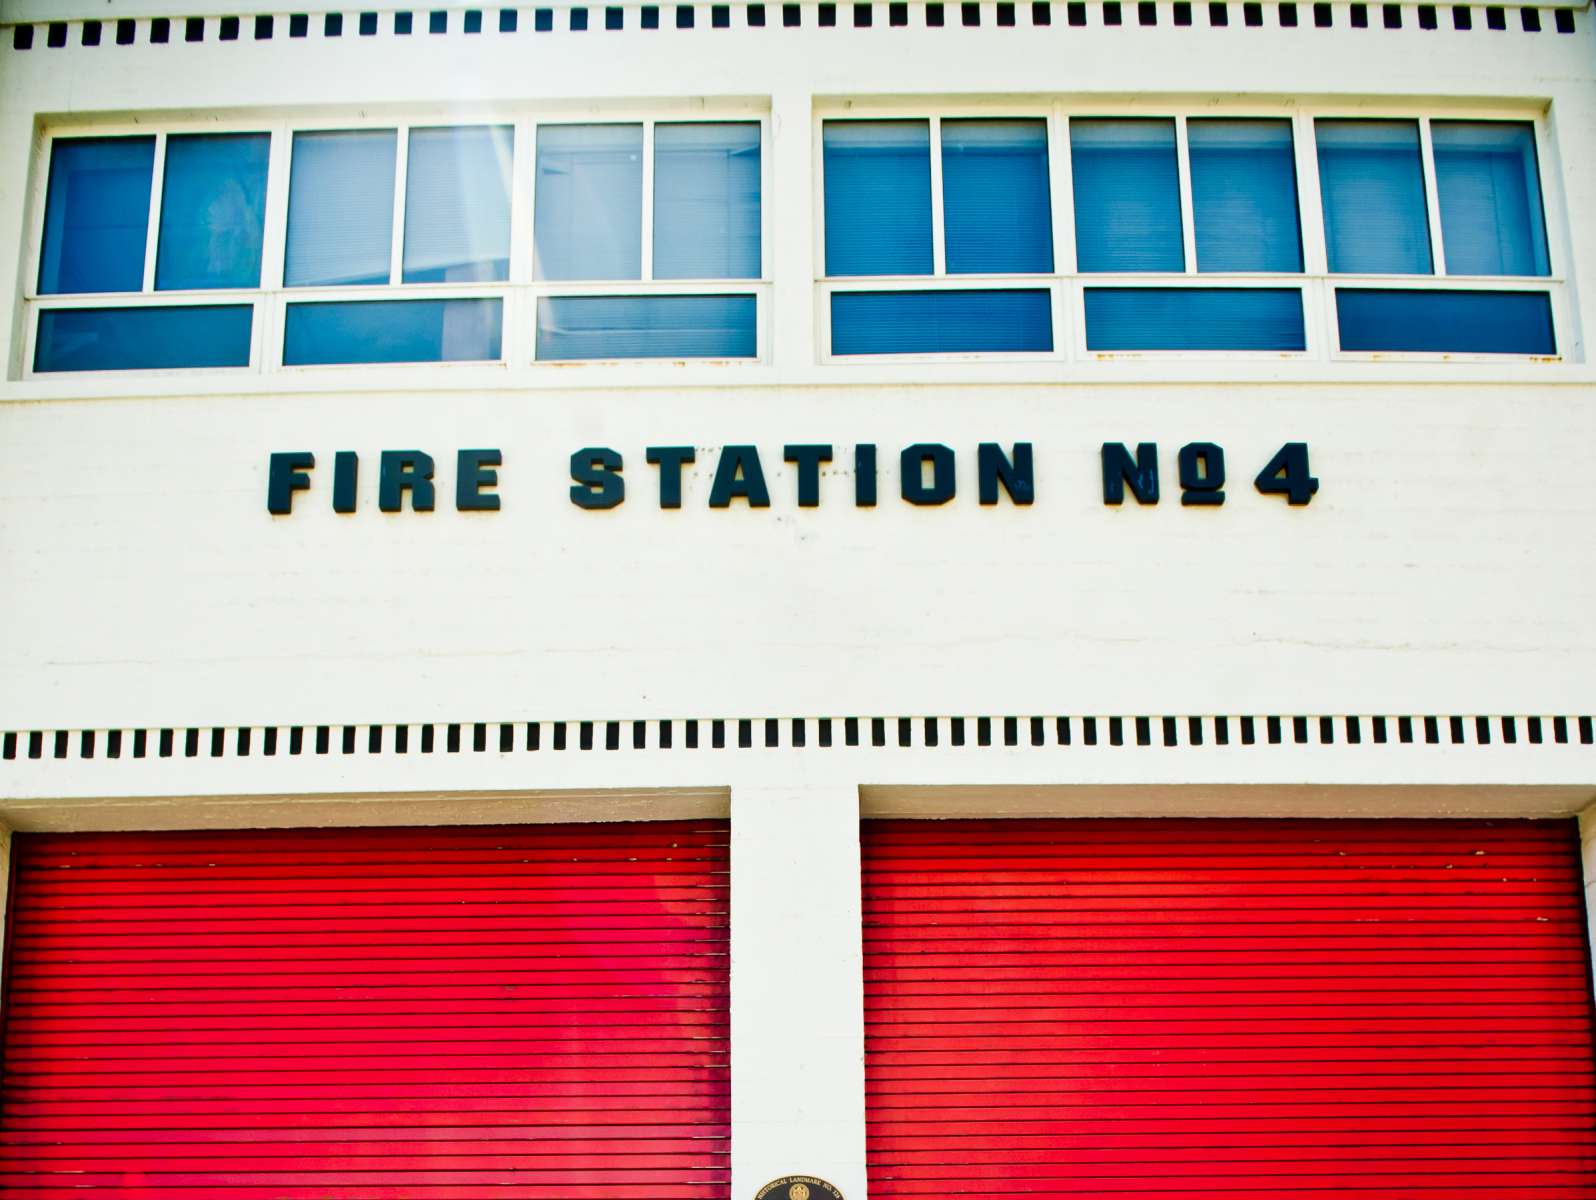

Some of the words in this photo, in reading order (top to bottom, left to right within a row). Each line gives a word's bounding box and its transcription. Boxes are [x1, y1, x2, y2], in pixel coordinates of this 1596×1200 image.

[268, 449, 502, 516] FIRE
[570, 442, 1035, 512] STATION
[789, 1177, 822, 1186] LANDMARK
